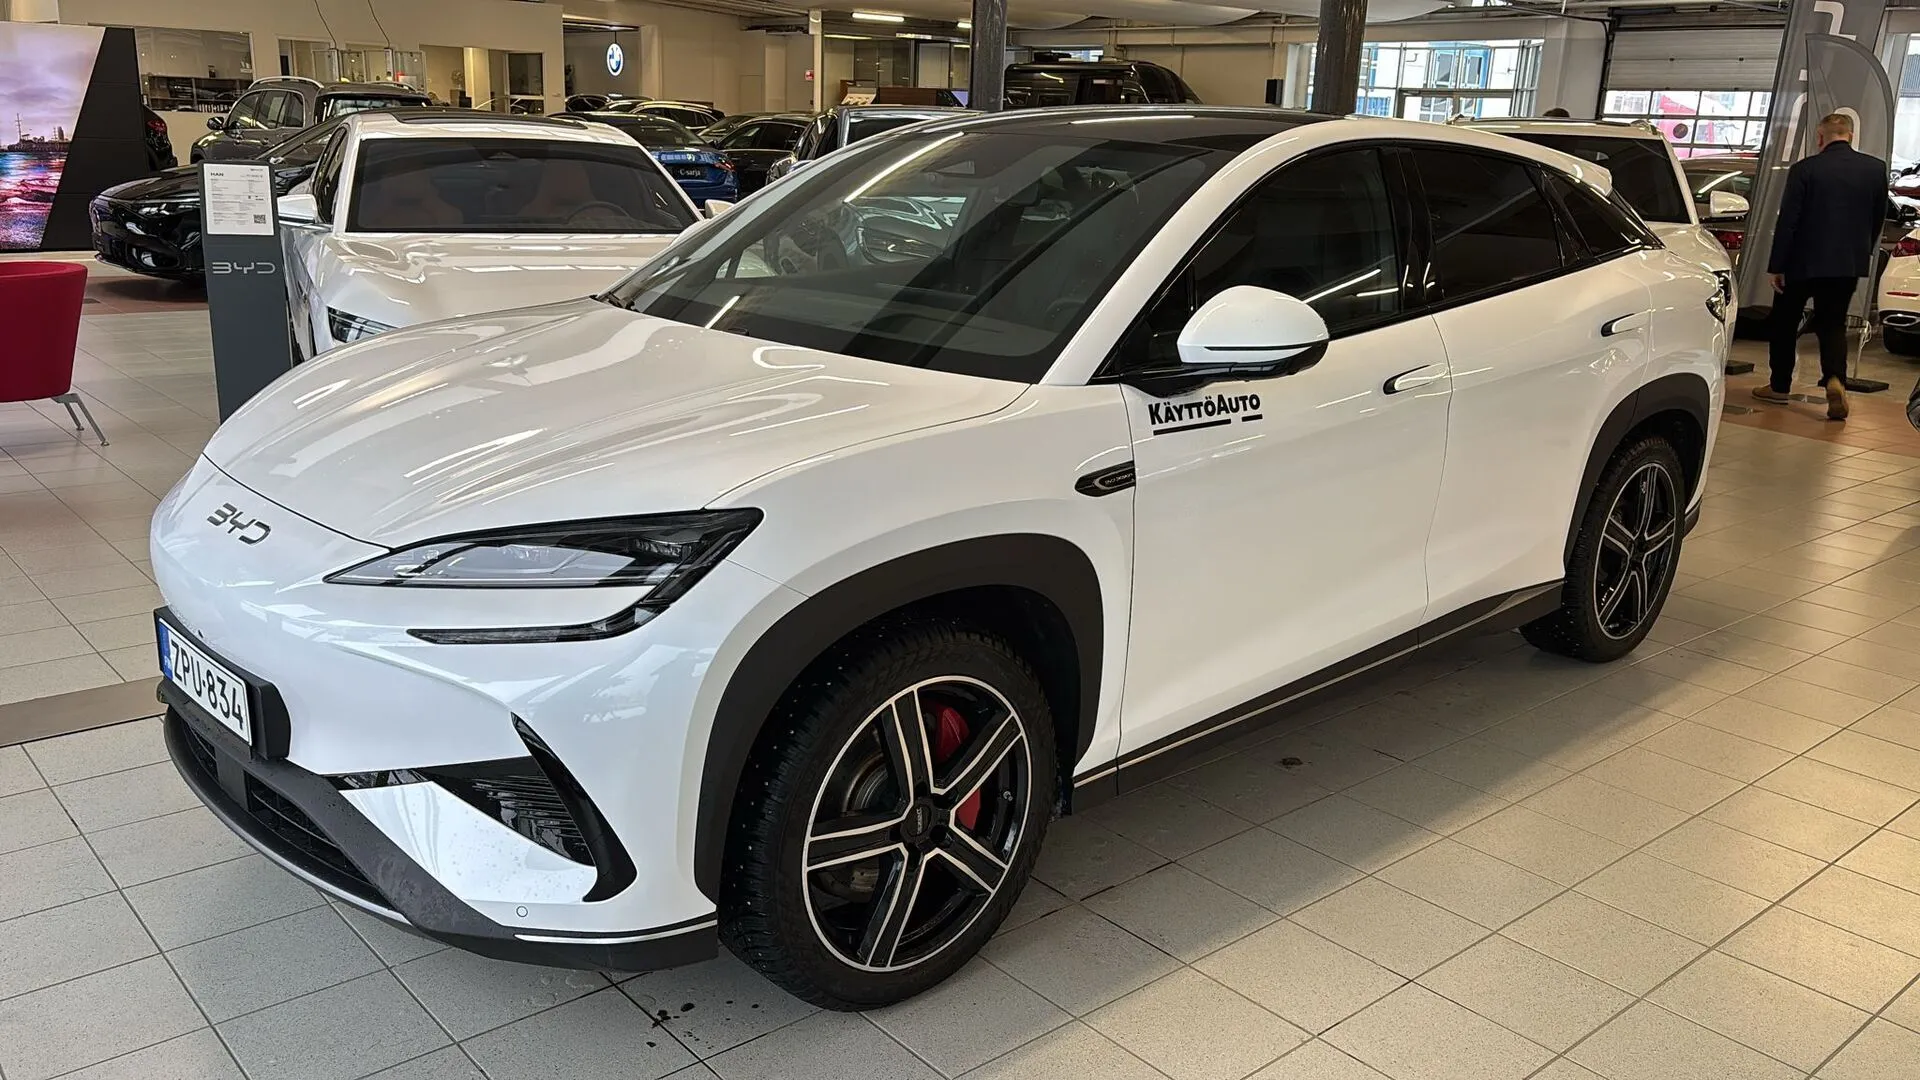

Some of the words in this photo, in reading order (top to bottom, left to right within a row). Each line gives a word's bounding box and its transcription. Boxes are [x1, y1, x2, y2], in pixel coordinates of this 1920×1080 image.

[680, 169, 700, 177] C-sarja
[212, 262, 275, 274] BYD
[1148, 394, 1261, 425] KÄYTTÖAUTO
[207, 502, 271, 545] BYD
[171, 639, 243, 730] ZPU-834
